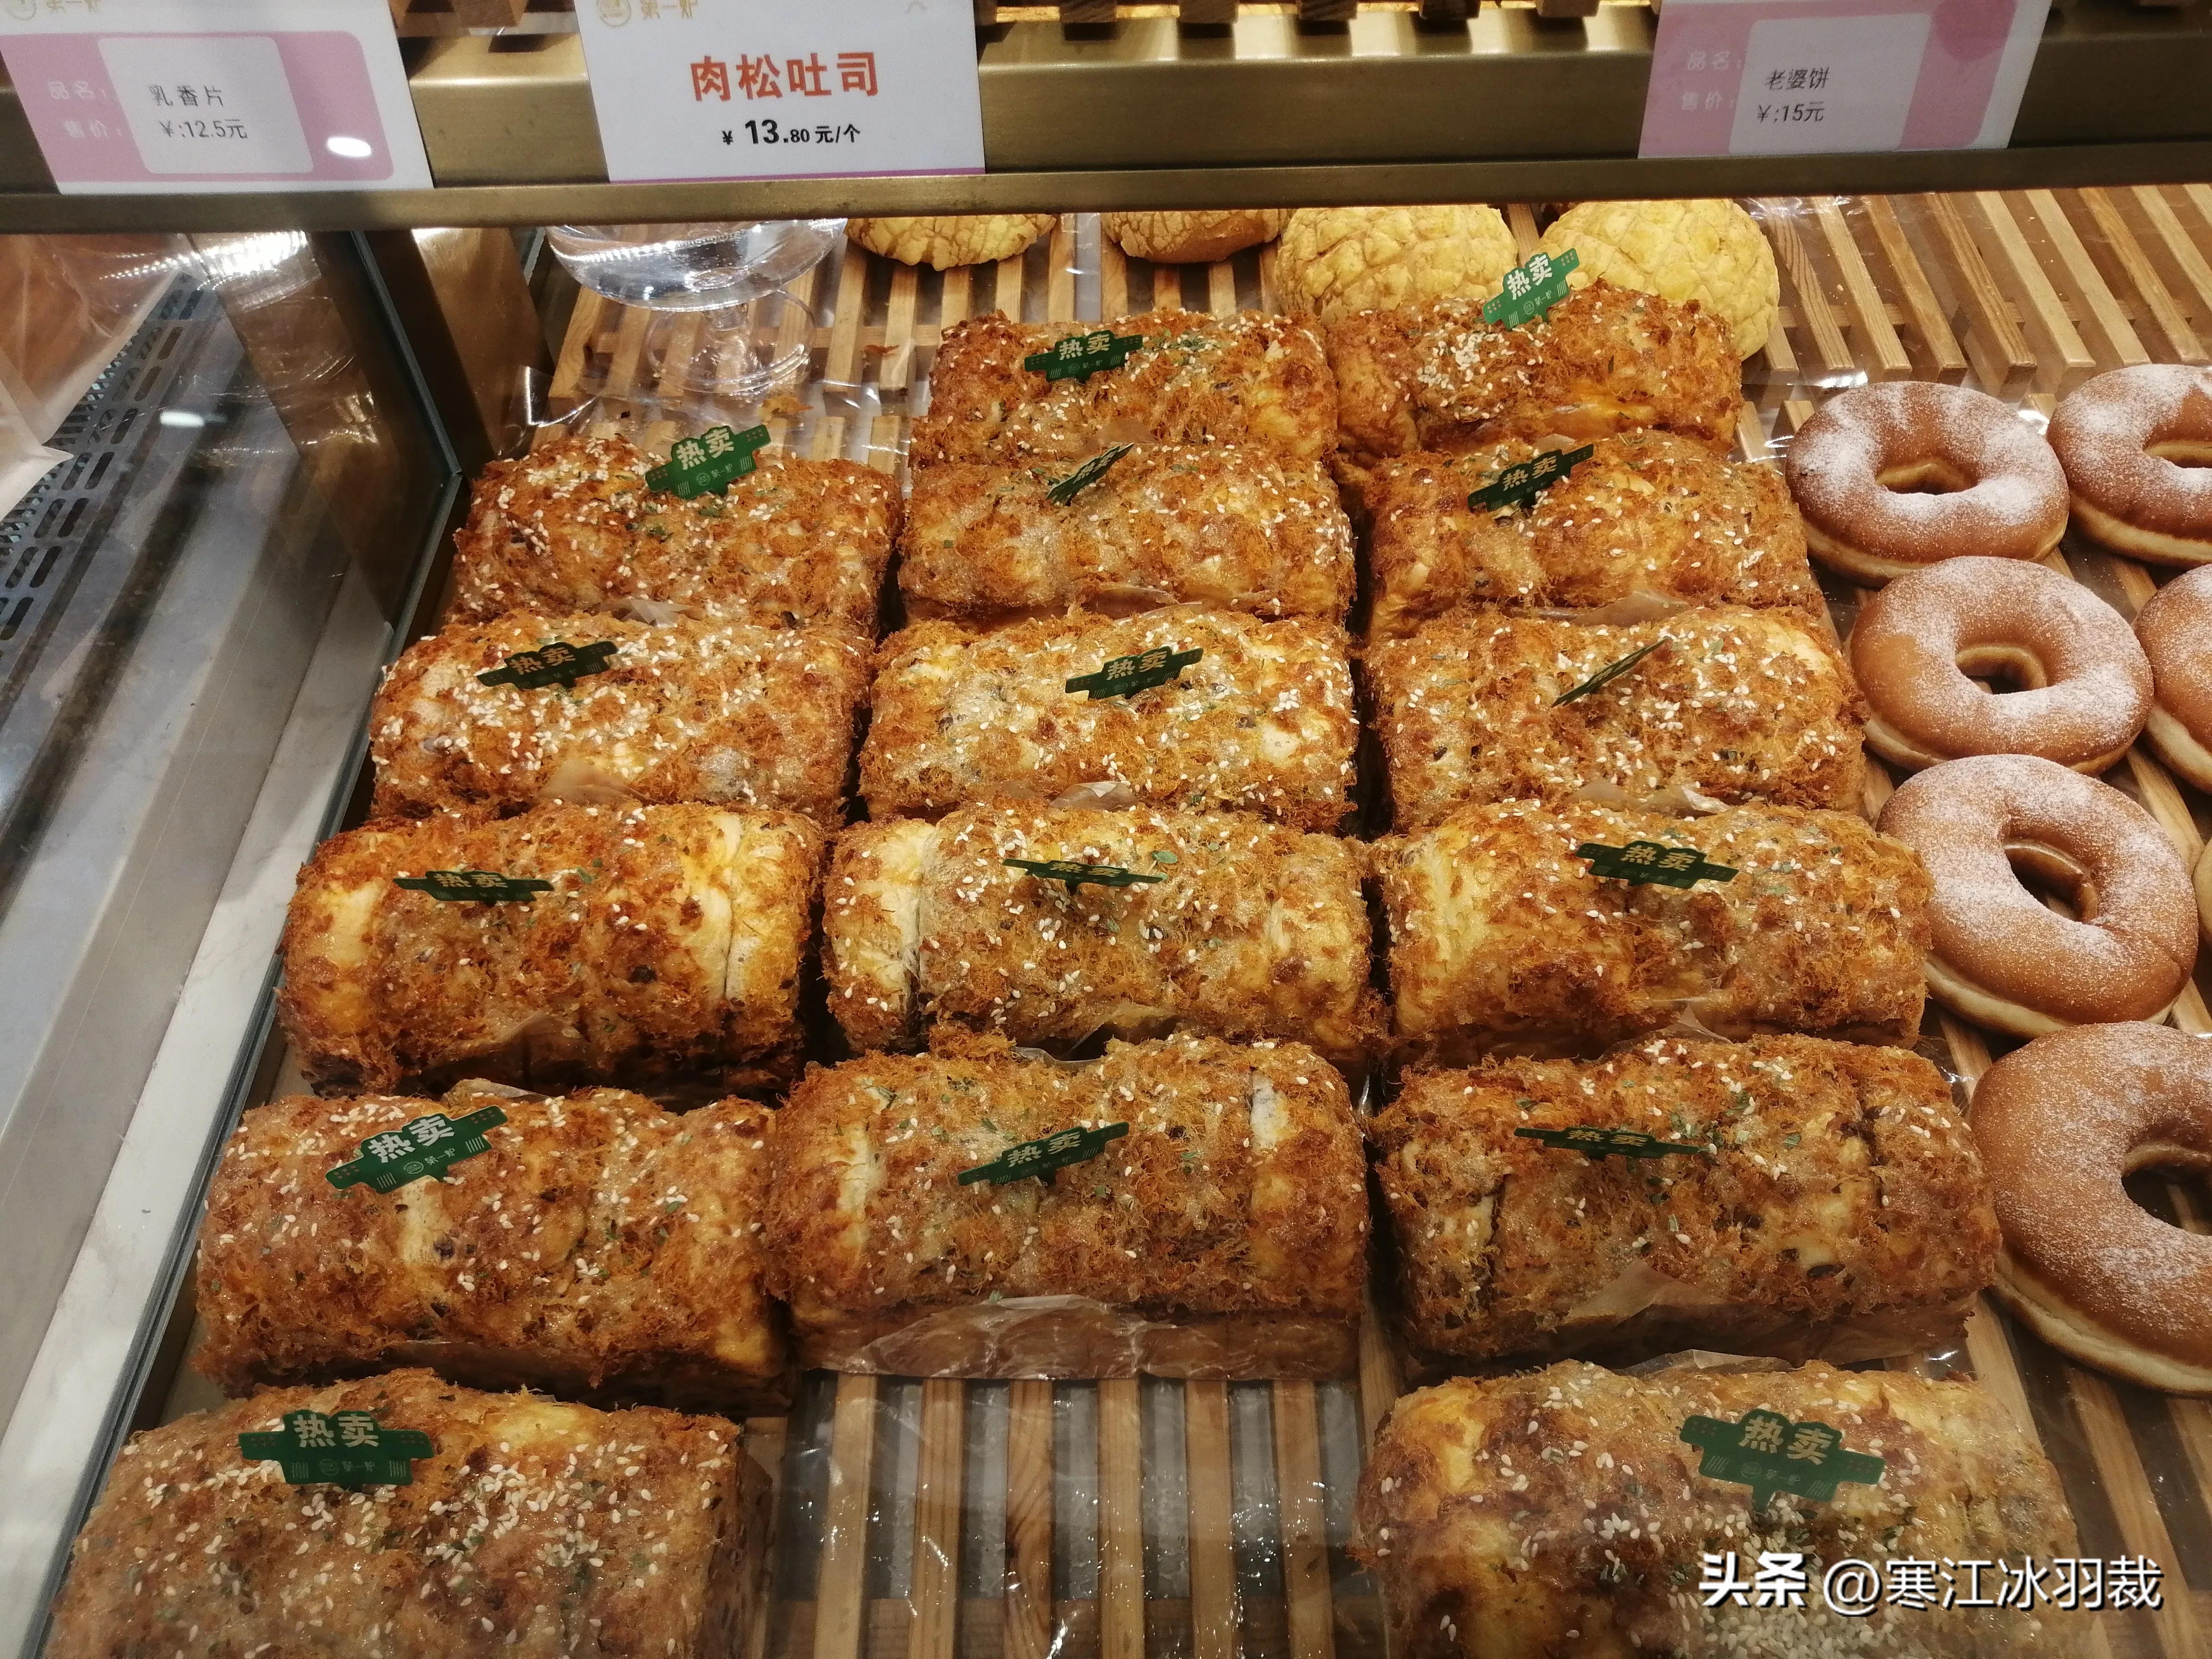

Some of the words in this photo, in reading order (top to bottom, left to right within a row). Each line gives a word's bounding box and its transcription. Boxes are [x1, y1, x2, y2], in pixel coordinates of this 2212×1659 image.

[690, 51, 879, 102] 肉松吐司
[1765, 67, 1830, 90] 老婆饼
[150, 85, 224, 107] 乳香片
[1507, 254, 1553, 300] 热卖
[1059, 334, 1110, 360] 热卖
[677, 428, 734, 470] 热卖
[1502, 456, 1557, 491] 热卖
[509, 647, 577, 675] 热卖
[1106, 651, 1167, 681] 热卖
[1620, 845, 1697, 872] 热卖
[433, 874, 509, 888] 热卖
[368, 1116, 455, 1163] 热卖
[1007, 1131, 1082, 1168] 热卖
[293, 1414, 380, 1448] 热卖
[1738, 1414, 1834, 1465] 热卖
